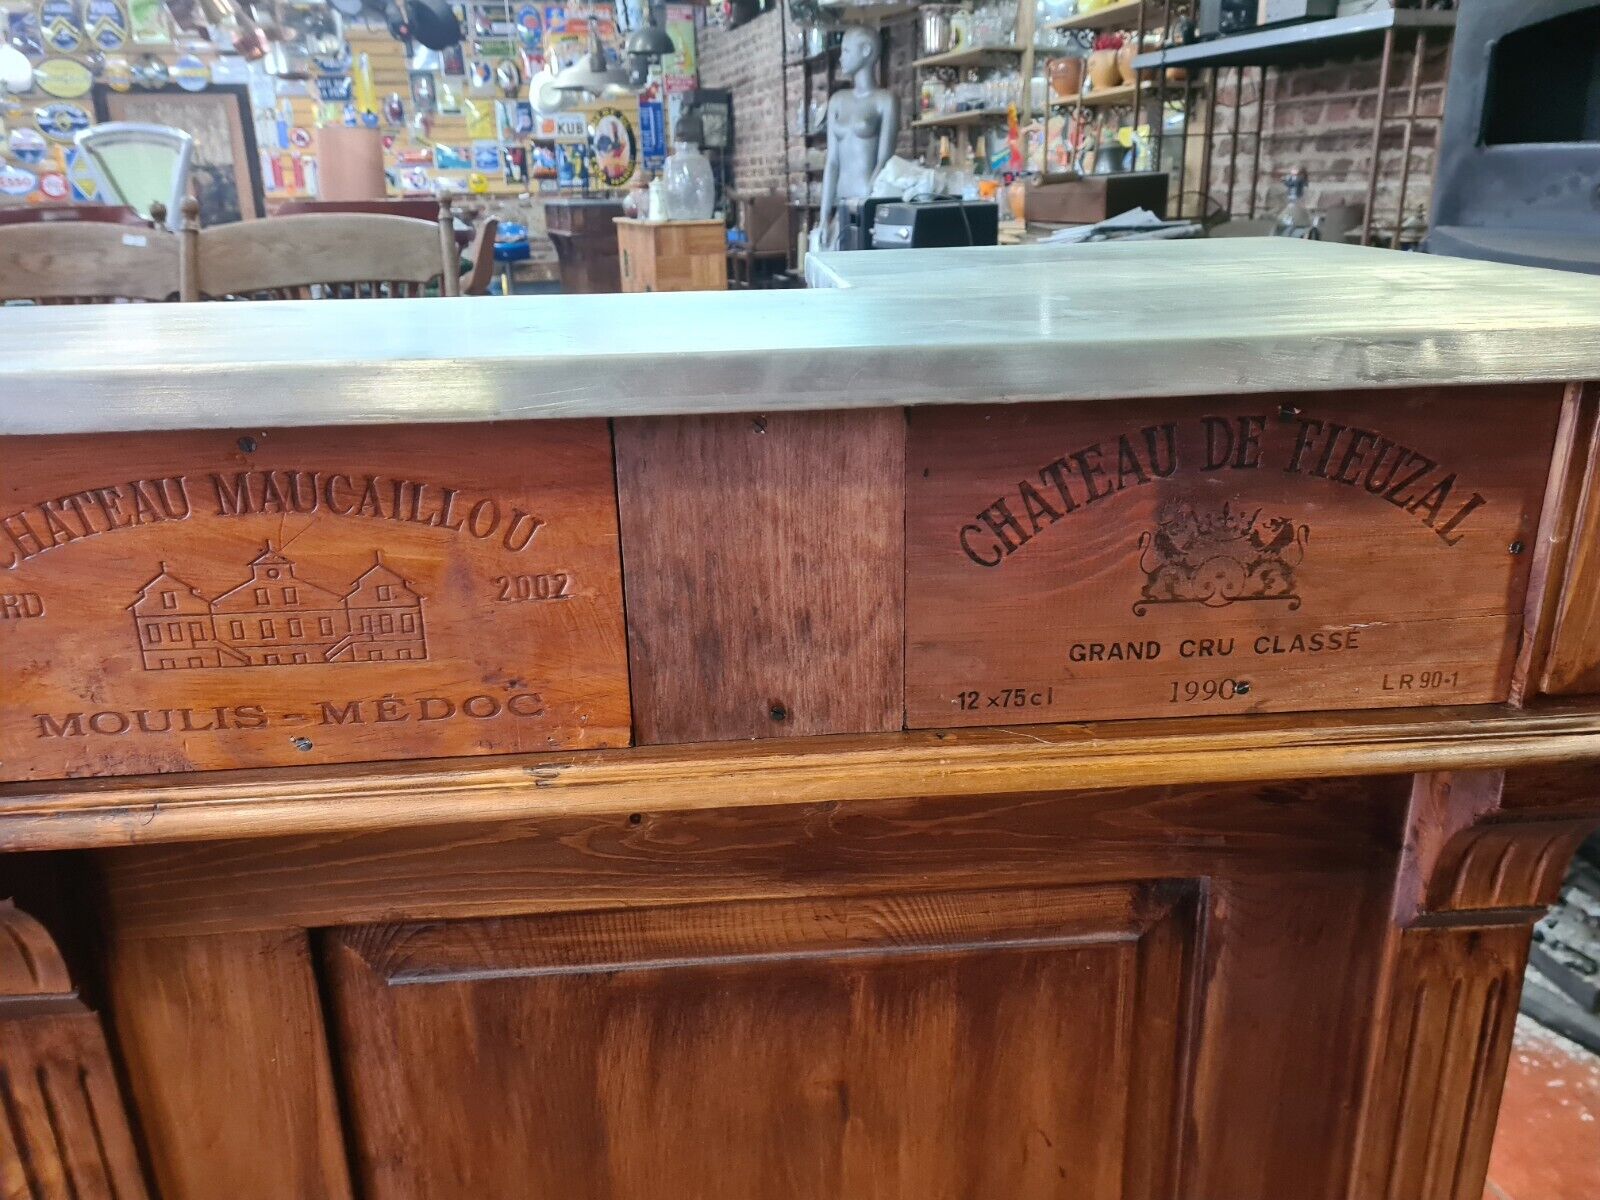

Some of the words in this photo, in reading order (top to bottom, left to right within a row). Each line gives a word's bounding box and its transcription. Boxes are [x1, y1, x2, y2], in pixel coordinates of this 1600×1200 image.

[557, 122, 584, 135] KUB
[959, 422, 1179, 568] CHATEAU
[1201, 414, 1268, 473] DE
[1282, 416, 1488, 547] FIEUZAL
[209, 470, 547, 552] MAUCAILLOU
[496, 573, 573, 602] 2002
[1068, 641, 1162, 663] GRAND
[1178, 637, 1235, 659] CRU
[1253, 628, 1361, 655] CLASSÉ
[1168, 678, 1238, 703] 1990
[33, 704, 270, 739] MOULIS
[315, 692, 545, 727] MÉDOC
